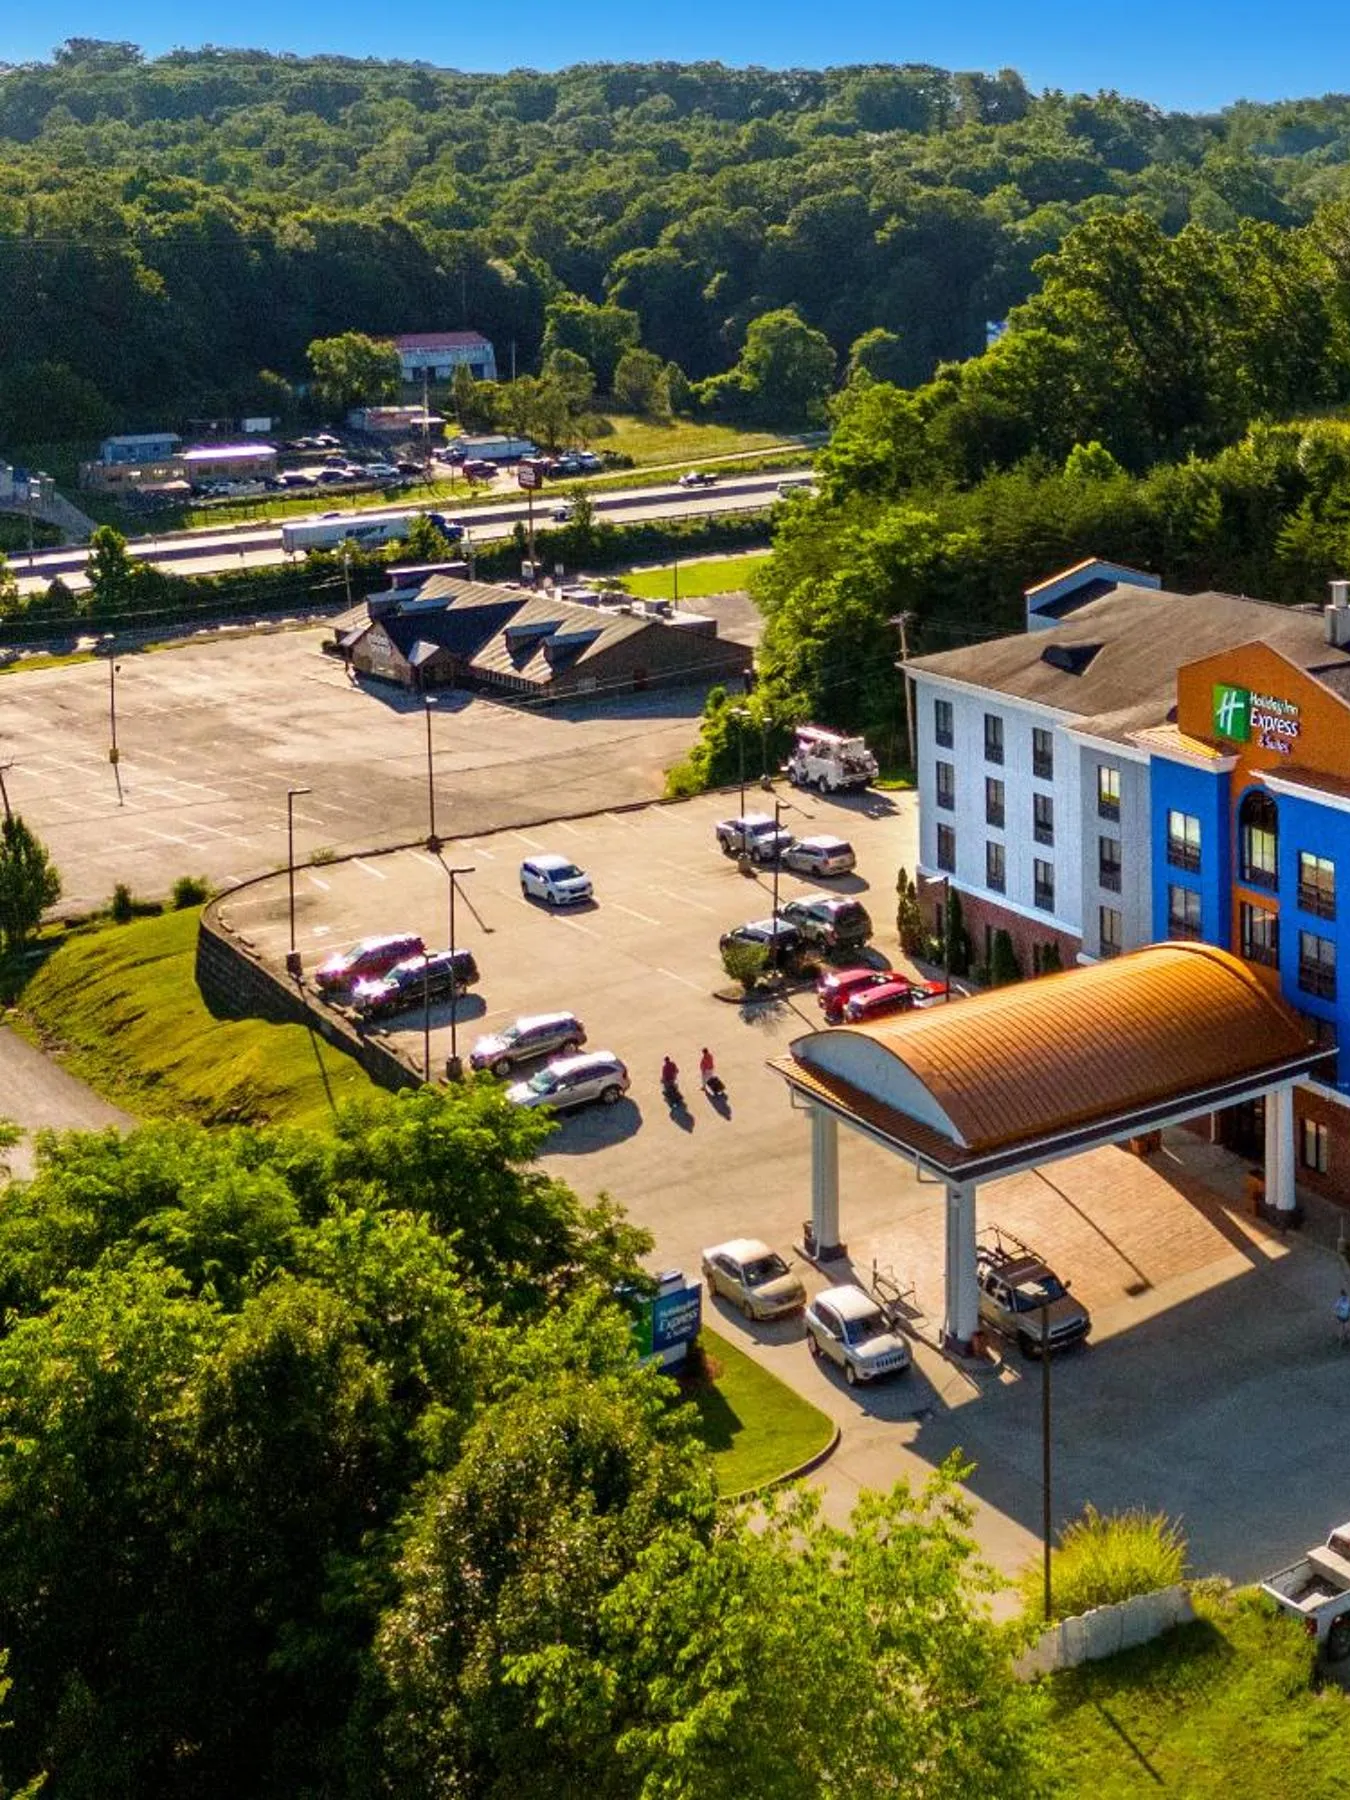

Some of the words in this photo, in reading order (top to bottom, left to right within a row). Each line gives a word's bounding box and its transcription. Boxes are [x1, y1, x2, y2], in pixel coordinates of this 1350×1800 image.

[1250, 691, 1283, 715] Holiday
[1284, 699, 1299, 715] Inn
[1250, 707, 1298, 737] Express
[659, 1310, 698, 1332] Express
